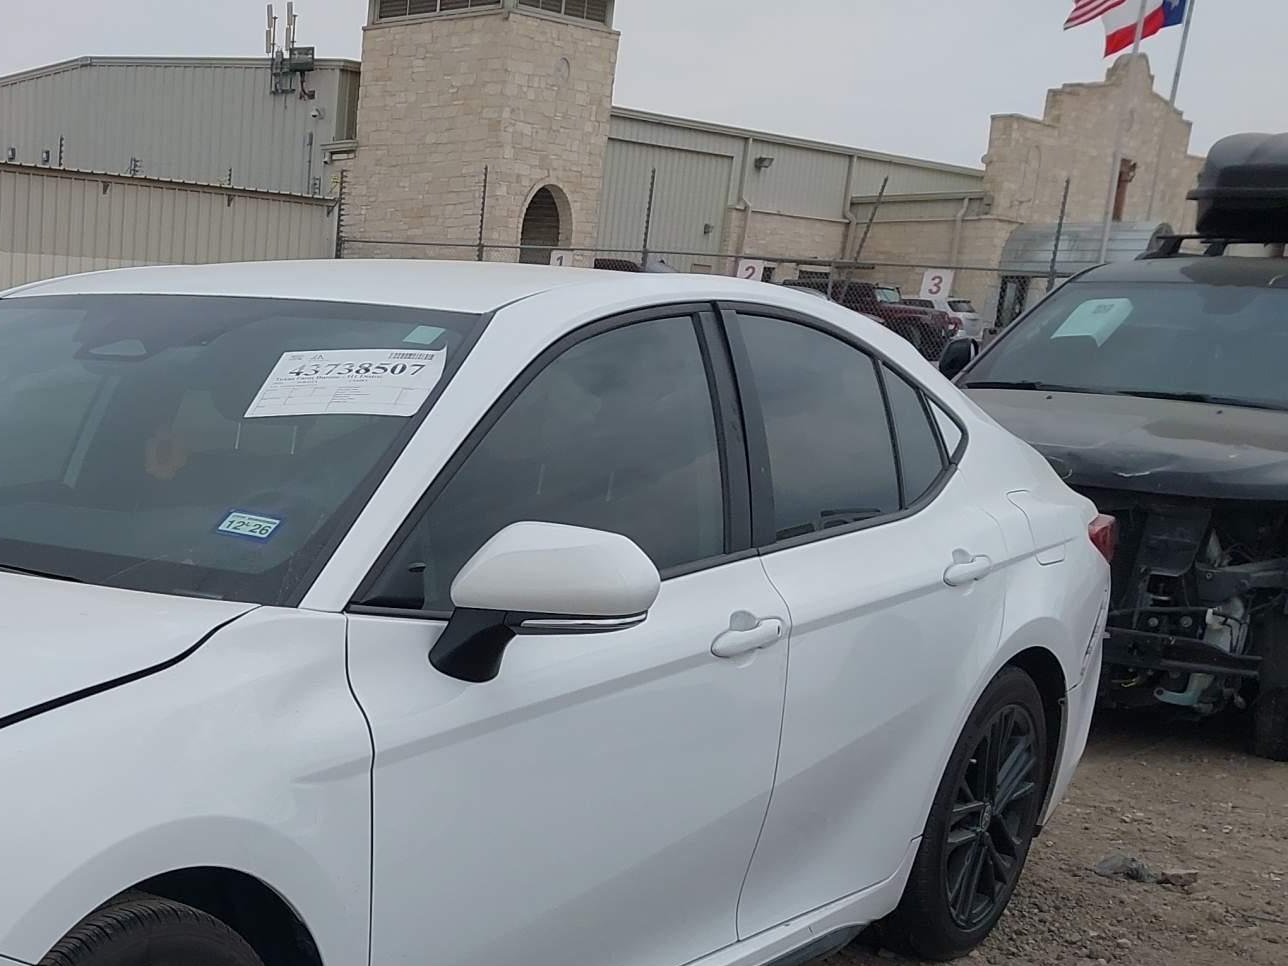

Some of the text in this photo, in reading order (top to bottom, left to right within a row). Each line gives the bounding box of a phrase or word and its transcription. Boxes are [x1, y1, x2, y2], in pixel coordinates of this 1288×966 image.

[744, 265, 756, 279] 2
[928, 275, 943, 295] 3
[288, 362, 426, 377] 43738507
[248, 523, 272, 536] 26
